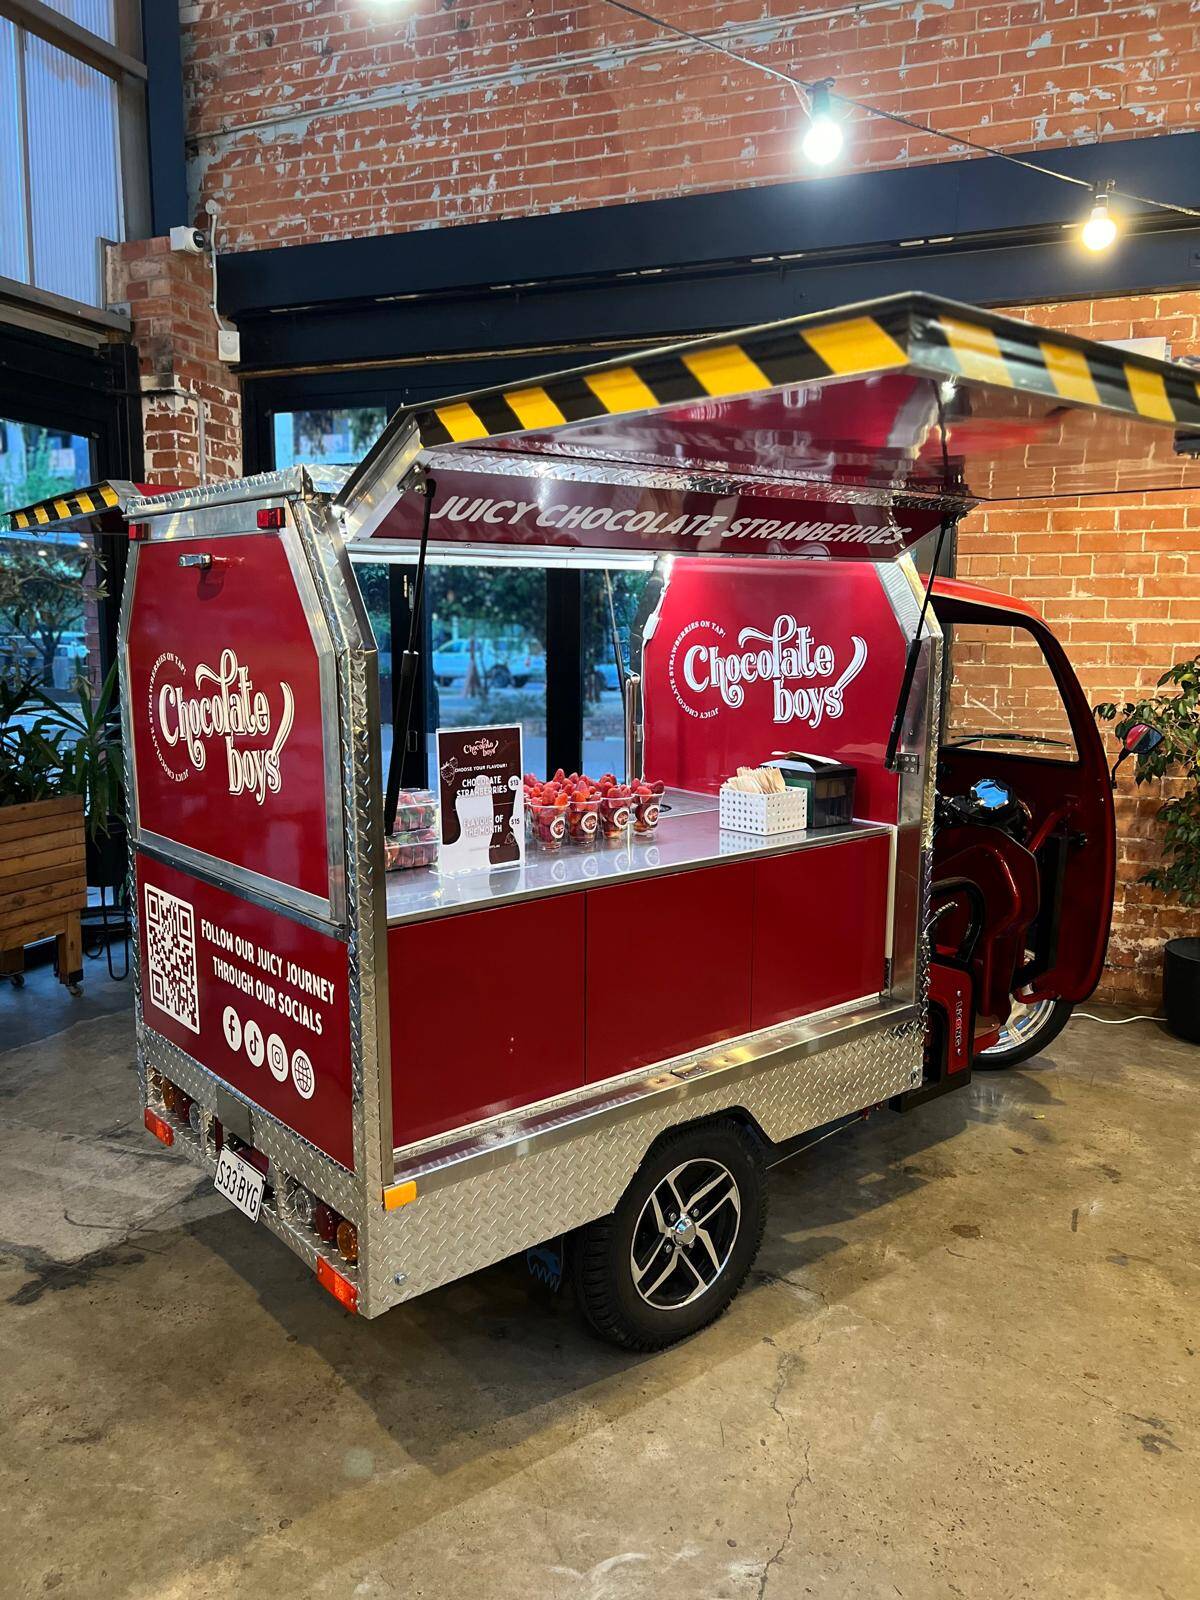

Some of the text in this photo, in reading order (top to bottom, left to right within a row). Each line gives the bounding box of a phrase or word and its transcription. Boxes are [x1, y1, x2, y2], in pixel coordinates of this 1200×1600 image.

[430, 495, 912, 545] JUICY CHOCOLATE STRAWBERRIES
[669, 621, 699, 677] STRAWBERRIES
[683, 614, 835, 709] Chocolate
[159, 648, 271, 771] Chocolate
[669, 678, 699, 718] CHOCOLATE
[700, 707, 719, 719] JUICY
[495, 814, 504, 823] OF
[201, 918, 335, 1005] FOLLOW OUR JUICY JOURNEY
[212, 956, 323, 1036] THROUGH OUR SOCIALS
